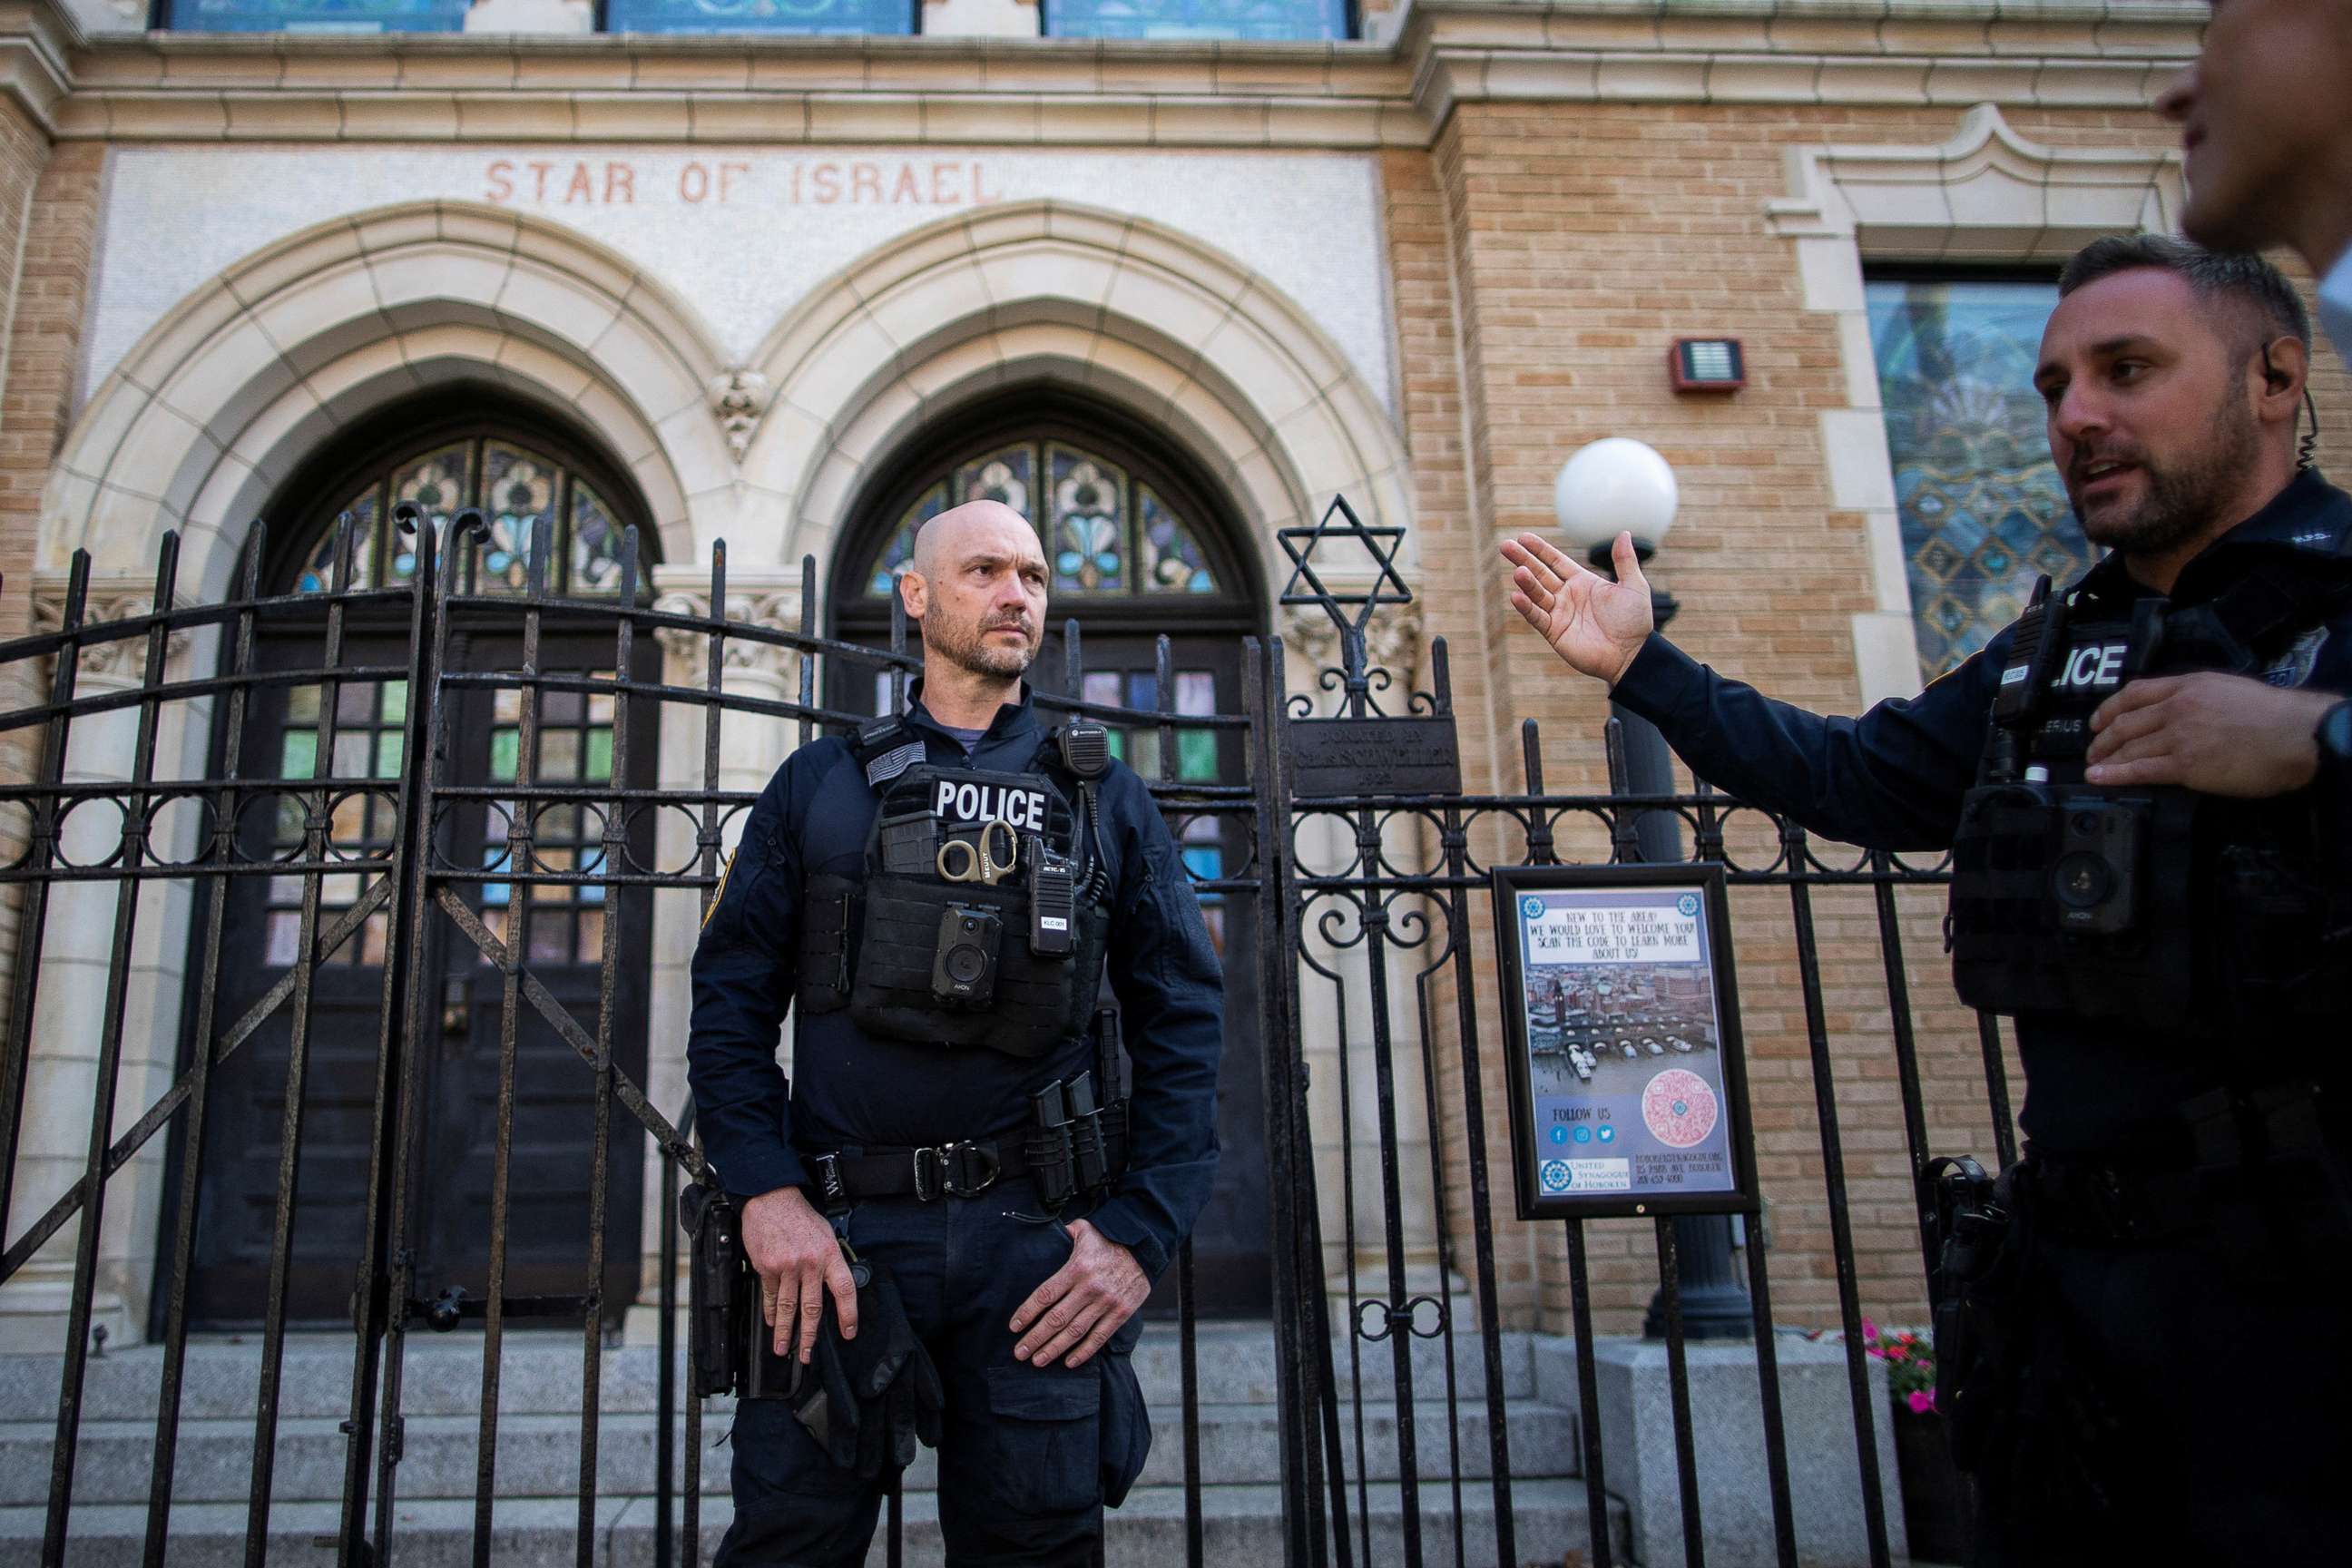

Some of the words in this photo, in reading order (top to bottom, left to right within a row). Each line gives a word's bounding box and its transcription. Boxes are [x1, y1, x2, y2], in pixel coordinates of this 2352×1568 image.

[485, 159, 636, 204] STAR
[681, 161, 750, 204] OF
[790, 161, 1003, 205] ISRAEL
[2050, 645, 2128, 688] ICE
[936, 780, 1045, 831] POLICE
[1566, 911, 1585, 923] NEW
[1592, 911, 1604, 923] TO
[1609, 911, 1625, 923] THE
[1530, 925, 1544, 936] WE
[1550, 925, 1581, 936] WOULD
[1585, 924, 1604, 936] LOVE
[1612, 924, 1623, 935] TO
[1628, 923, 1670, 935] WELCOME
[1538, 936, 1561, 949] SCAN
[1567, 936, 1583, 948] THE
[1587, 936, 1609, 947] CODE
[1616, 936, 1627, 946] TO
[1632, 936, 1659, 946] LEARN
[1663, 935, 1689, 946] MORE
[1592, 948, 1619, 959] ABOUT
[1553, 1108, 1592, 1122] FOLLOW
[1598, 1107, 1612, 1120] US
